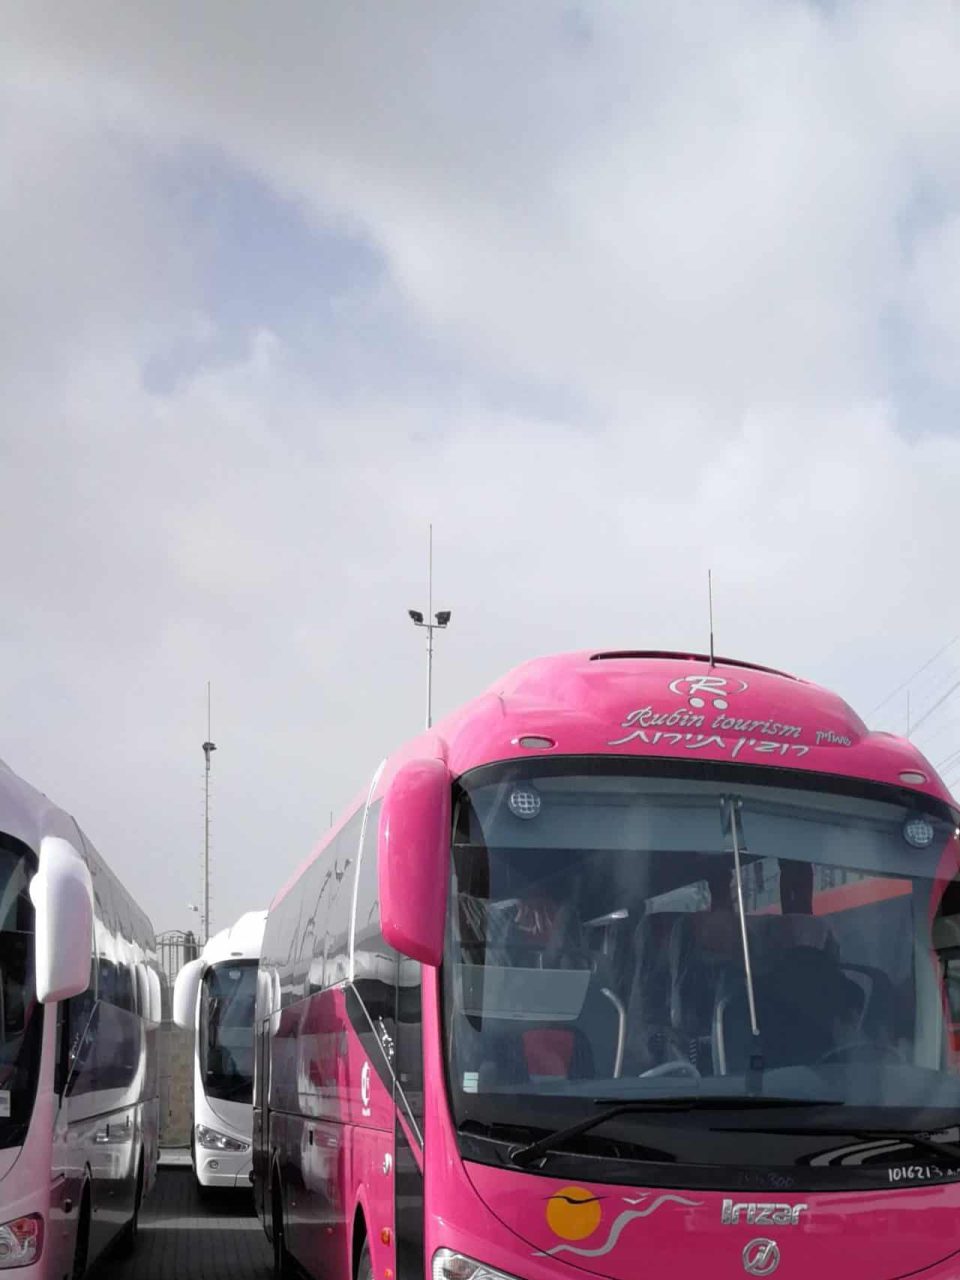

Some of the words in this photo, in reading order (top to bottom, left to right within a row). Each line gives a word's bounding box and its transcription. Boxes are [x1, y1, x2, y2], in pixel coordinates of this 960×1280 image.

[622, 706, 705, 729] Rubin
[711, 713, 802, 738] tourism
[731, 737, 810, 758] רובין
